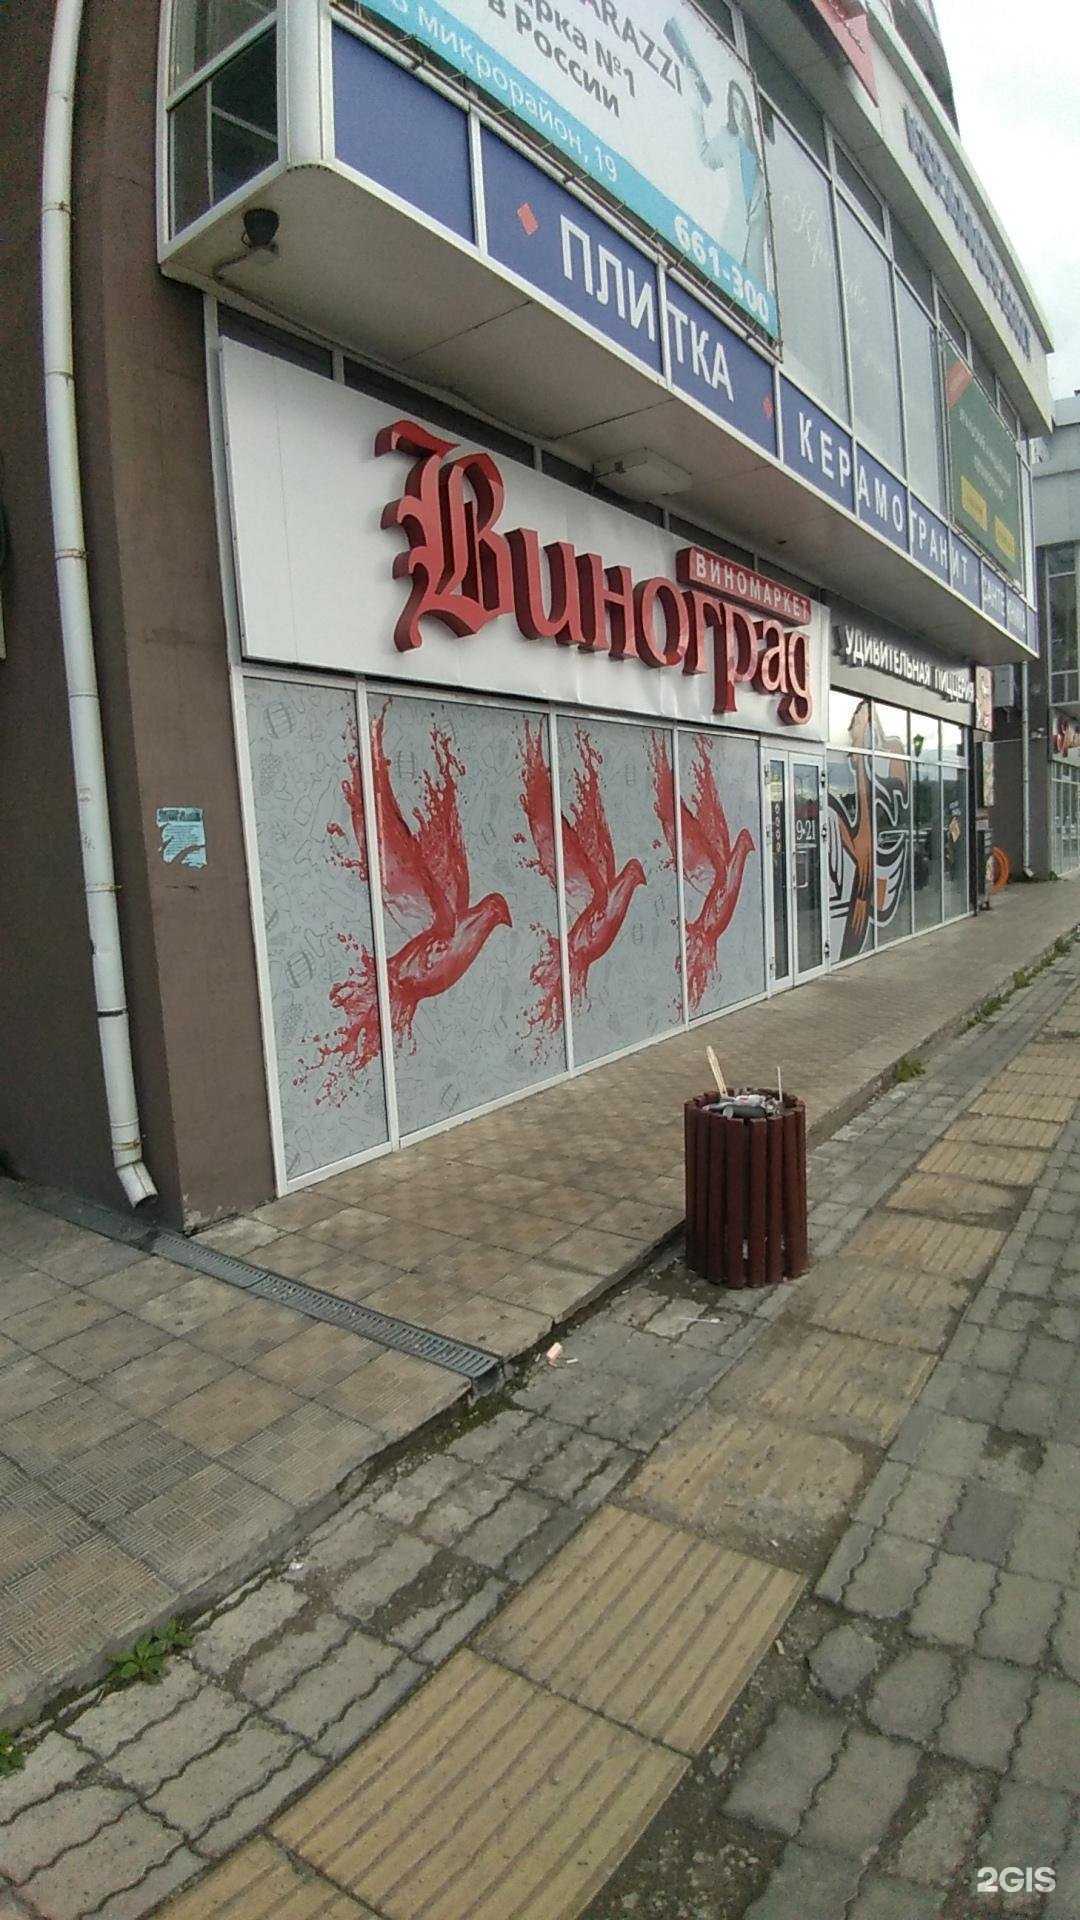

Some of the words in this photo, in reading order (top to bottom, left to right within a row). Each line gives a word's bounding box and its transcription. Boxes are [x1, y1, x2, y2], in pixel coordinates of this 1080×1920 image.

[514, 4, 620, 119] России
[596, 145, 618, 184] 19
[560, 214, 734, 402] ПЛИТКА
[673, 215, 769, 325] 661-300
[798, 411, 968, 584] КЕРАМОГРАНИТ
[695, 552, 809, 620] ВИНОМАРКЕТ
[845, 624, 931, 687] УДИВИТЕЛЬНАЯ
